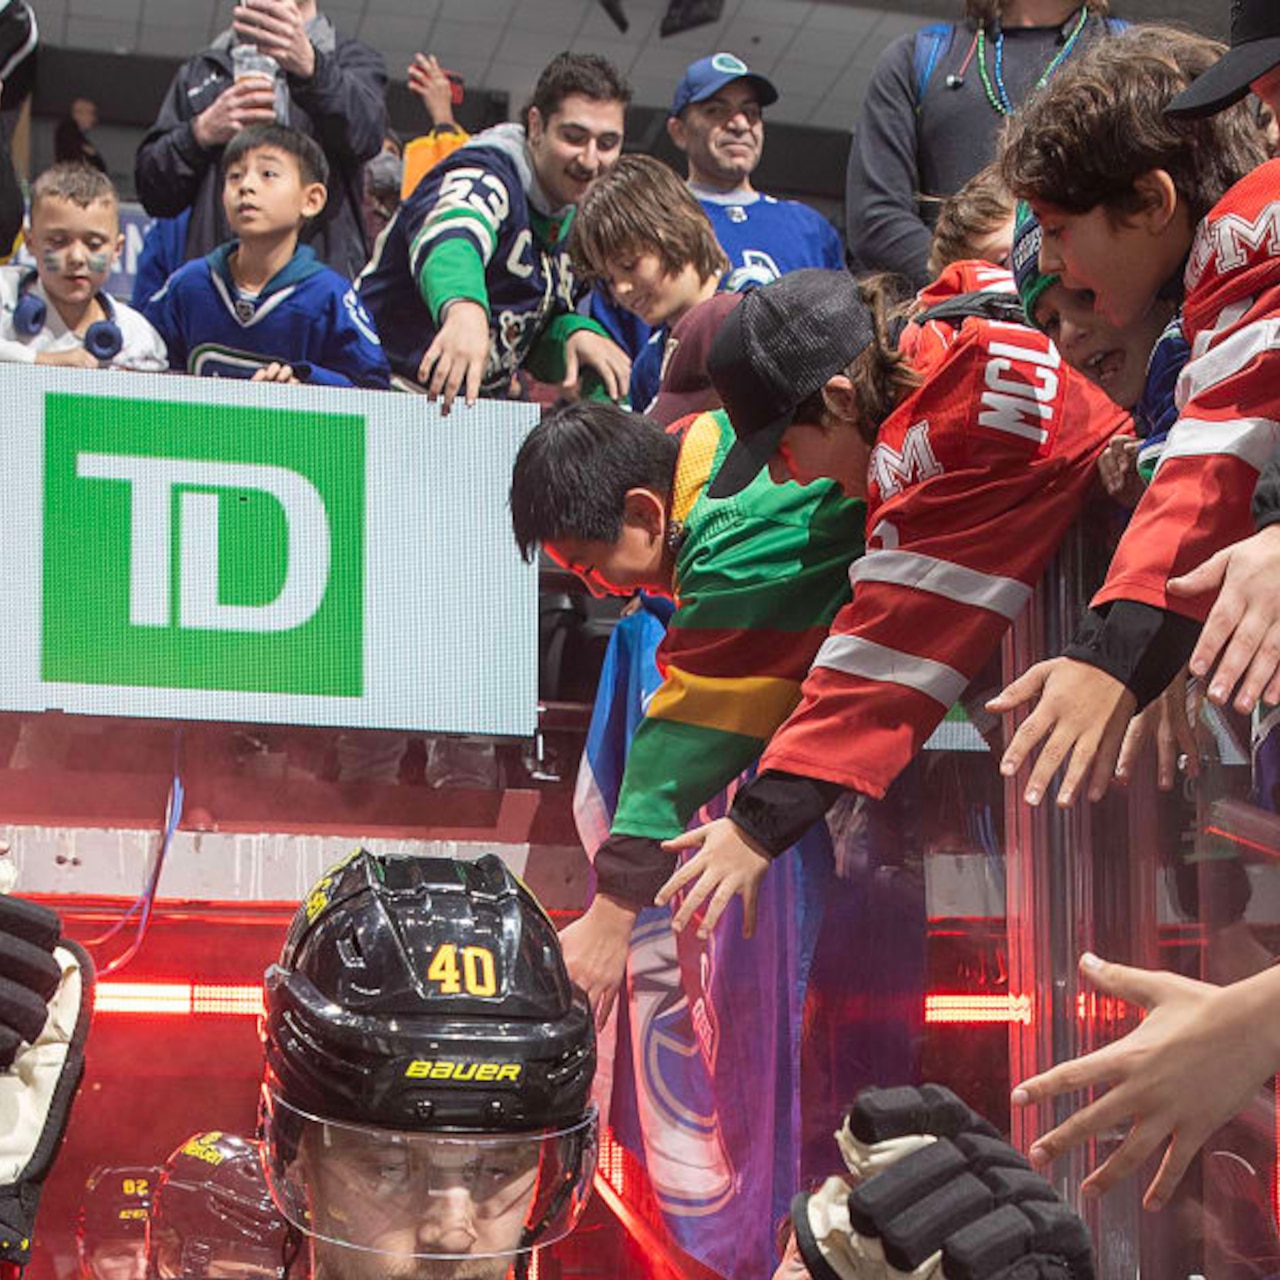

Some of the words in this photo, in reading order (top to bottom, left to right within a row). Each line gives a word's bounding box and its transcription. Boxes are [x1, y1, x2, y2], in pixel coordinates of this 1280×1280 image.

[439, 168, 510, 232] 53
[506, 228, 533, 279] C
[76, 452, 331, 634] TD
[427, 943, 497, 998] 40
